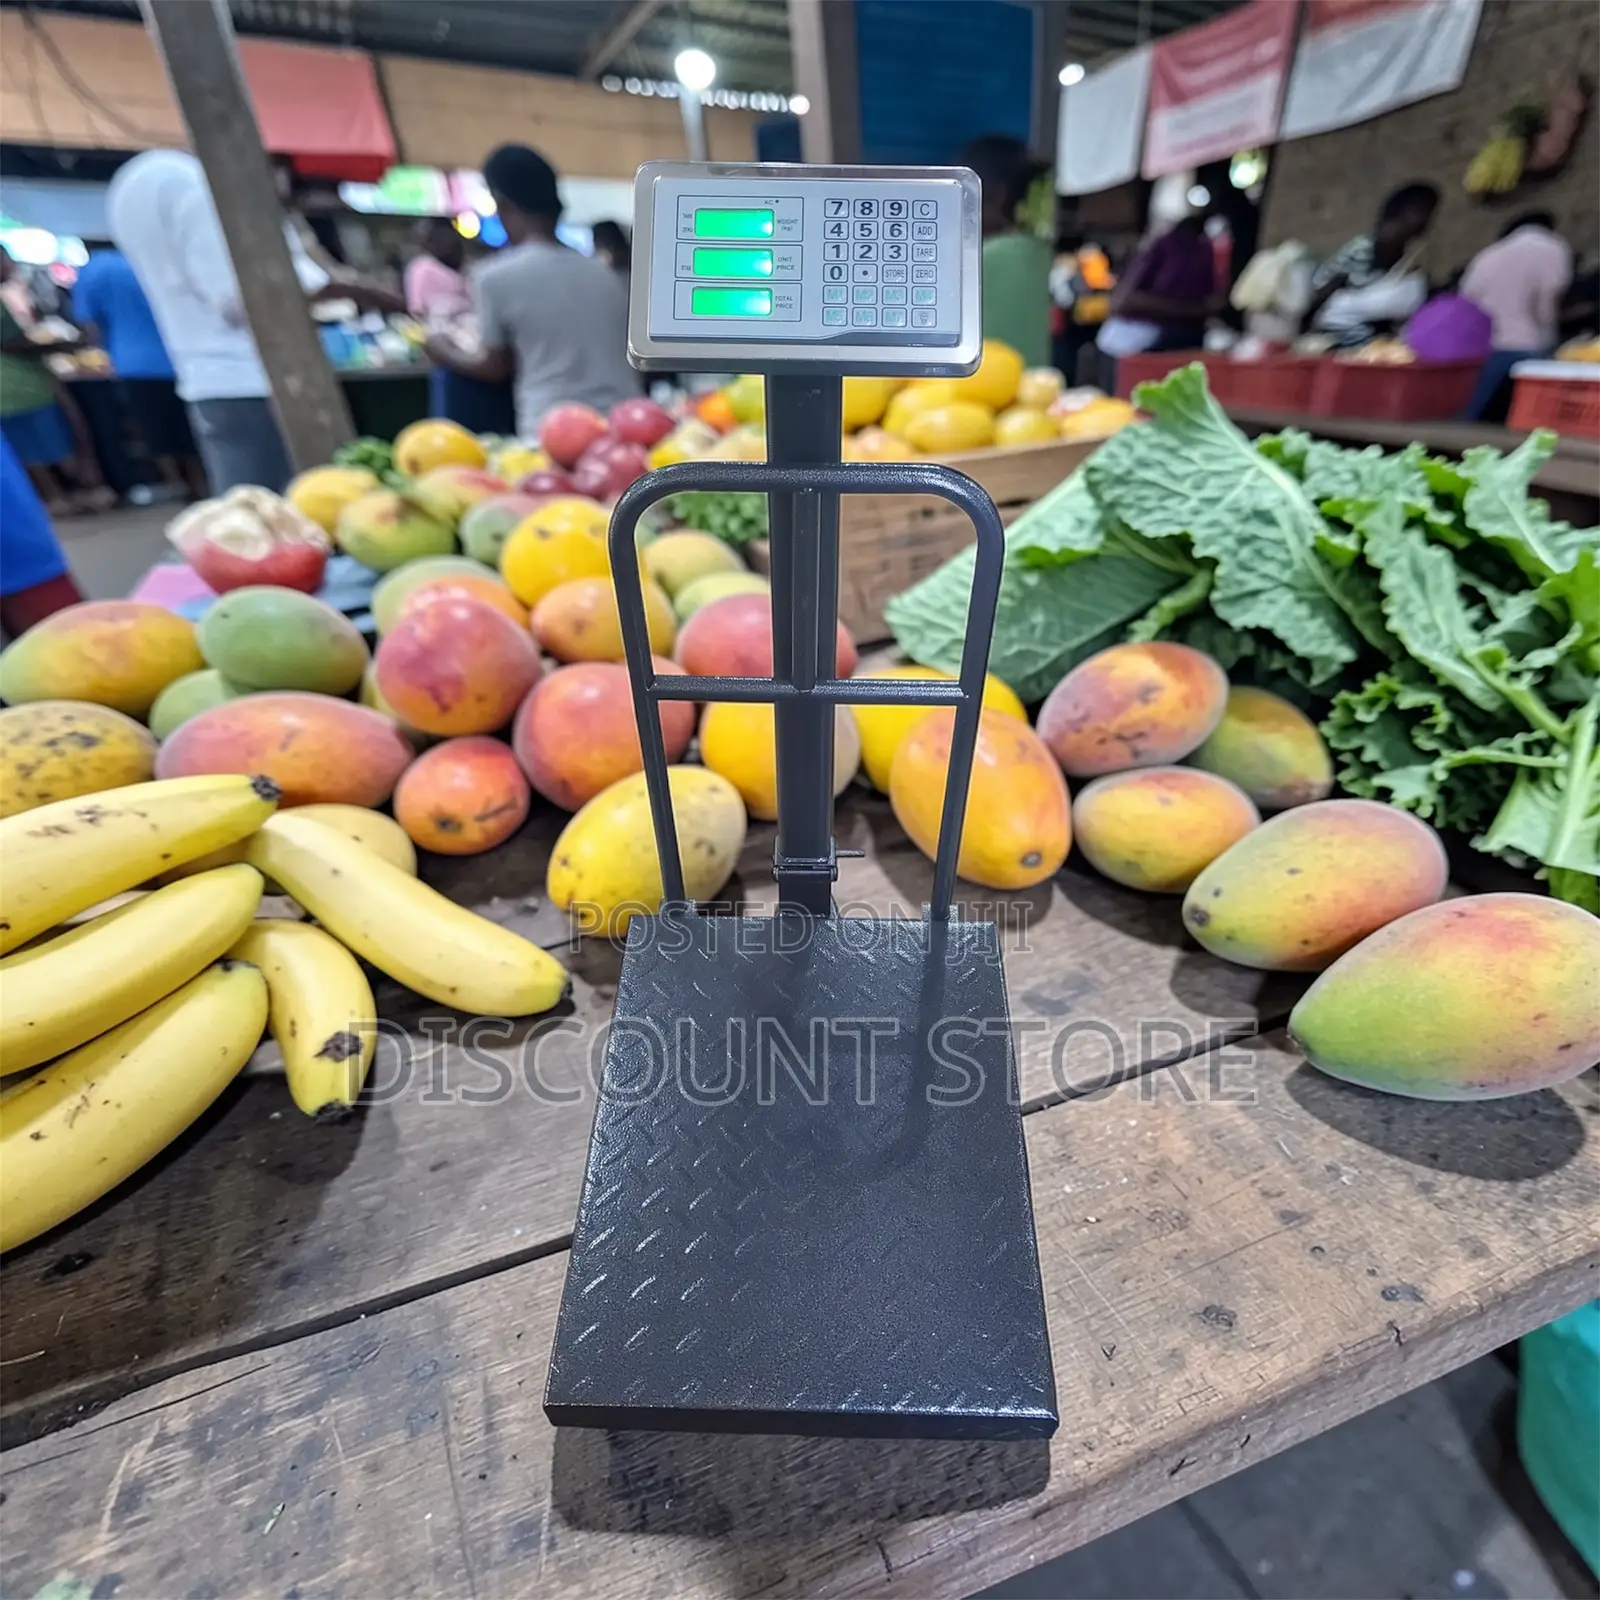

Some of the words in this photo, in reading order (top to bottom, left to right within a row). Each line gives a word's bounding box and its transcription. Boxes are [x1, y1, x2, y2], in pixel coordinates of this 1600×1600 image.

[831, 201, 843, 215] 7
[860, 202, 873, 216] 8
[890, 202, 902, 216] 9
[920, 203, 930, 216] C
[830, 223, 843, 237] 4
[860, 223, 872, 237] 5
[889, 224, 902, 237] 6
[917, 227, 932, 236] ADD
[832, 245, 840, 258] 1
[859, 245, 872, 259] 2
[889, 245, 902, 259] 3
[916, 248, 933, 256] TARE
[830, 266, 842, 280] 0
[885, 269, 905, 278] STORE
[915, 270, 933, 278] ZERO
